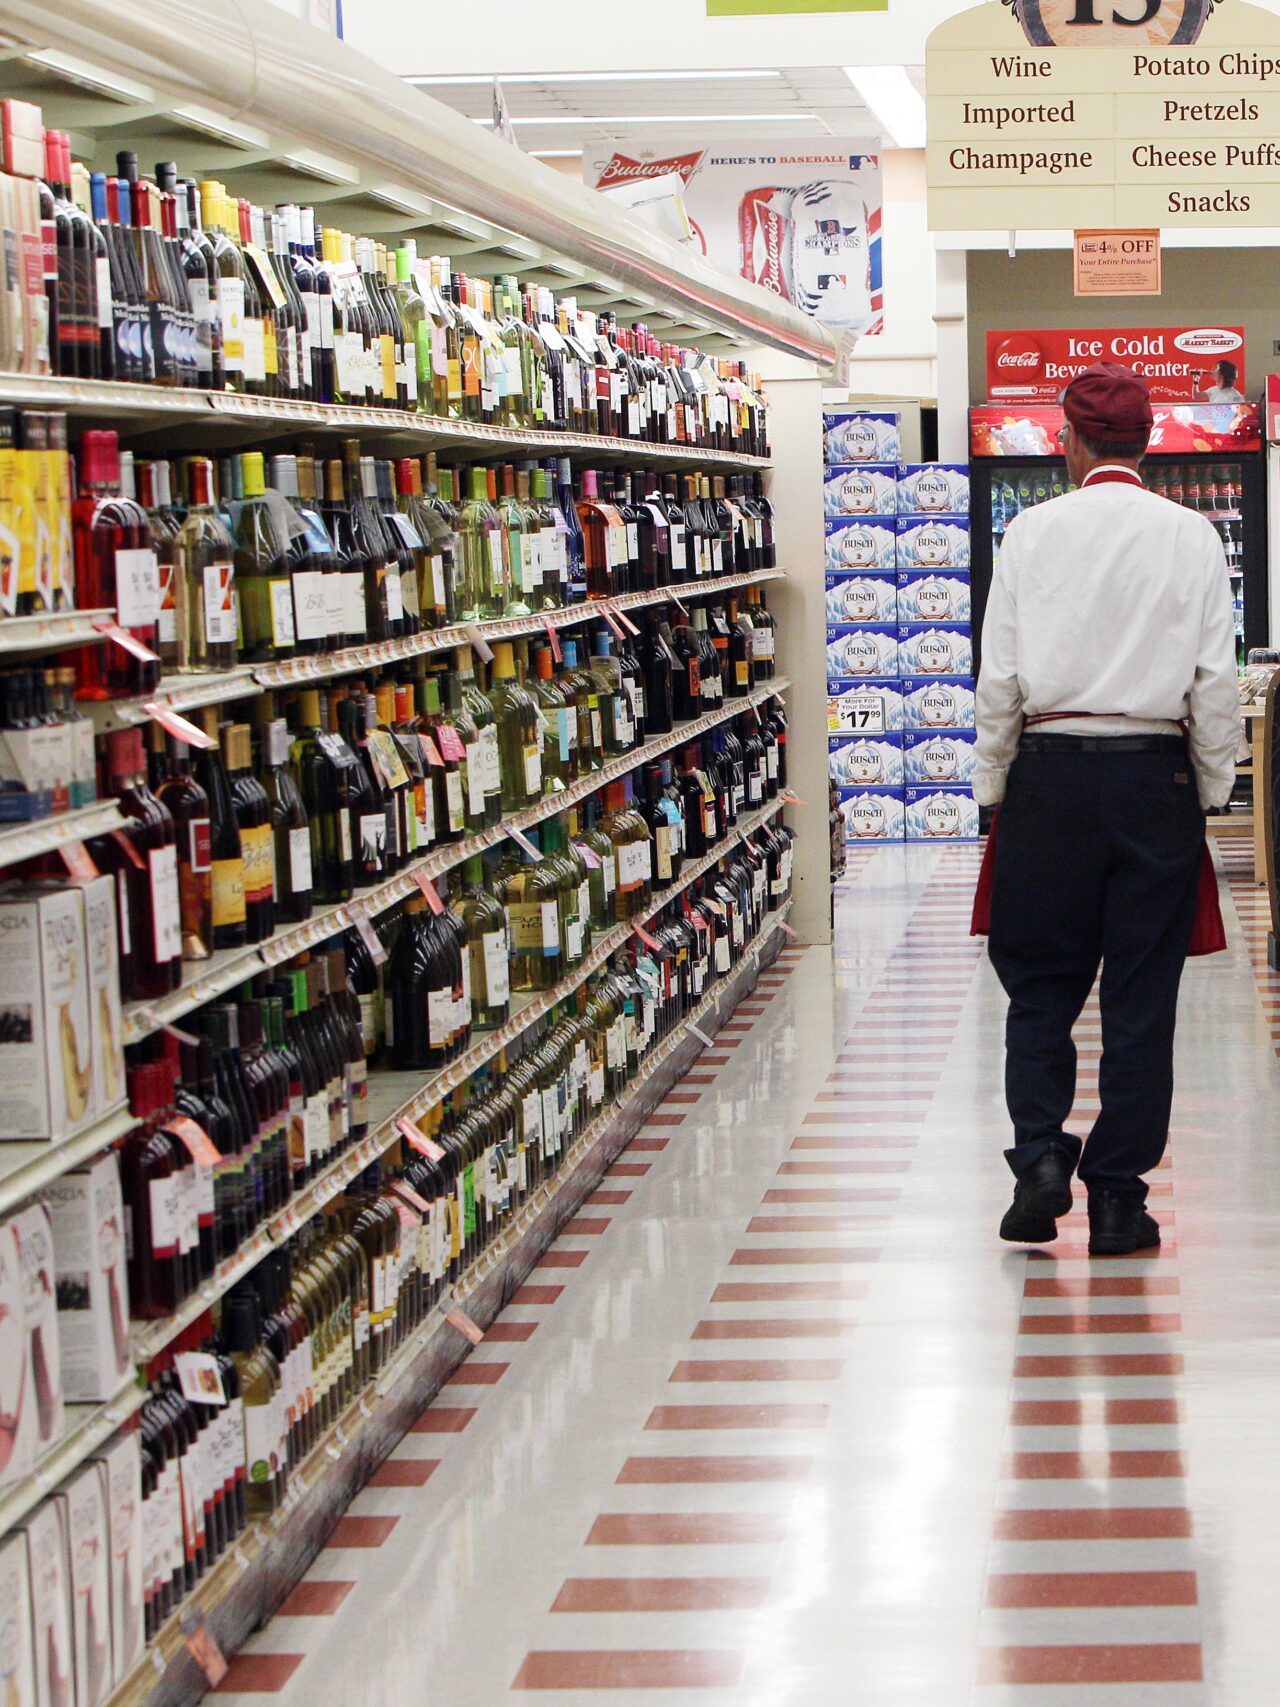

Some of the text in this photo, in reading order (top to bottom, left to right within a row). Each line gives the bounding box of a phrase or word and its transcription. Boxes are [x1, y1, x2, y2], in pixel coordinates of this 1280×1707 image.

[991, 57, 1052, 77] Wine
[1133, 55, 1210, 77] Potato
[963, 101, 1075, 129] Imported
[1163, 99, 1259, 122] Pretzels
[710, 154, 847, 166] HERE'S TO BASEBALL
[949, 148, 1092, 175] Champagne
[1132, 145, 1217, 168] Cheese
[595, 160, 703, 179] Budweiser
[1168, 191, 1250, 213] Snacks
[803, 236, 861, 249] CHAMPIONS
[1121, 240, 1154, 254] OFF
[763, 210, 782, 295] Budweise
[1068, 335, 1164, 357] Ice Cold
[1045, 360, 1190, 378] Beve Center
[846, 433, 874, 442] BUSCH
[843, 486, 872, 494] BUSCH
[918, 484, 947, 492] BUSCH
[844, 539, 873, 548] BUSCH
[918, 538, 947, 547] BUSCH
[846, 594, 875, 602] BUSCH
[919, 592, 948, 600] BUSCH
[847, 647, 876, 655] BUSCH
[920, 645, 949, 653] BUSCH
[923, 698, 952, 707] BUSCH
[850, 755, 879, 764] BUSCH
[925, 753, 954, 761] BUSCH
[853, 809, 882, 817] BUSCH
[928, 808, 957, 816] BUSCH
